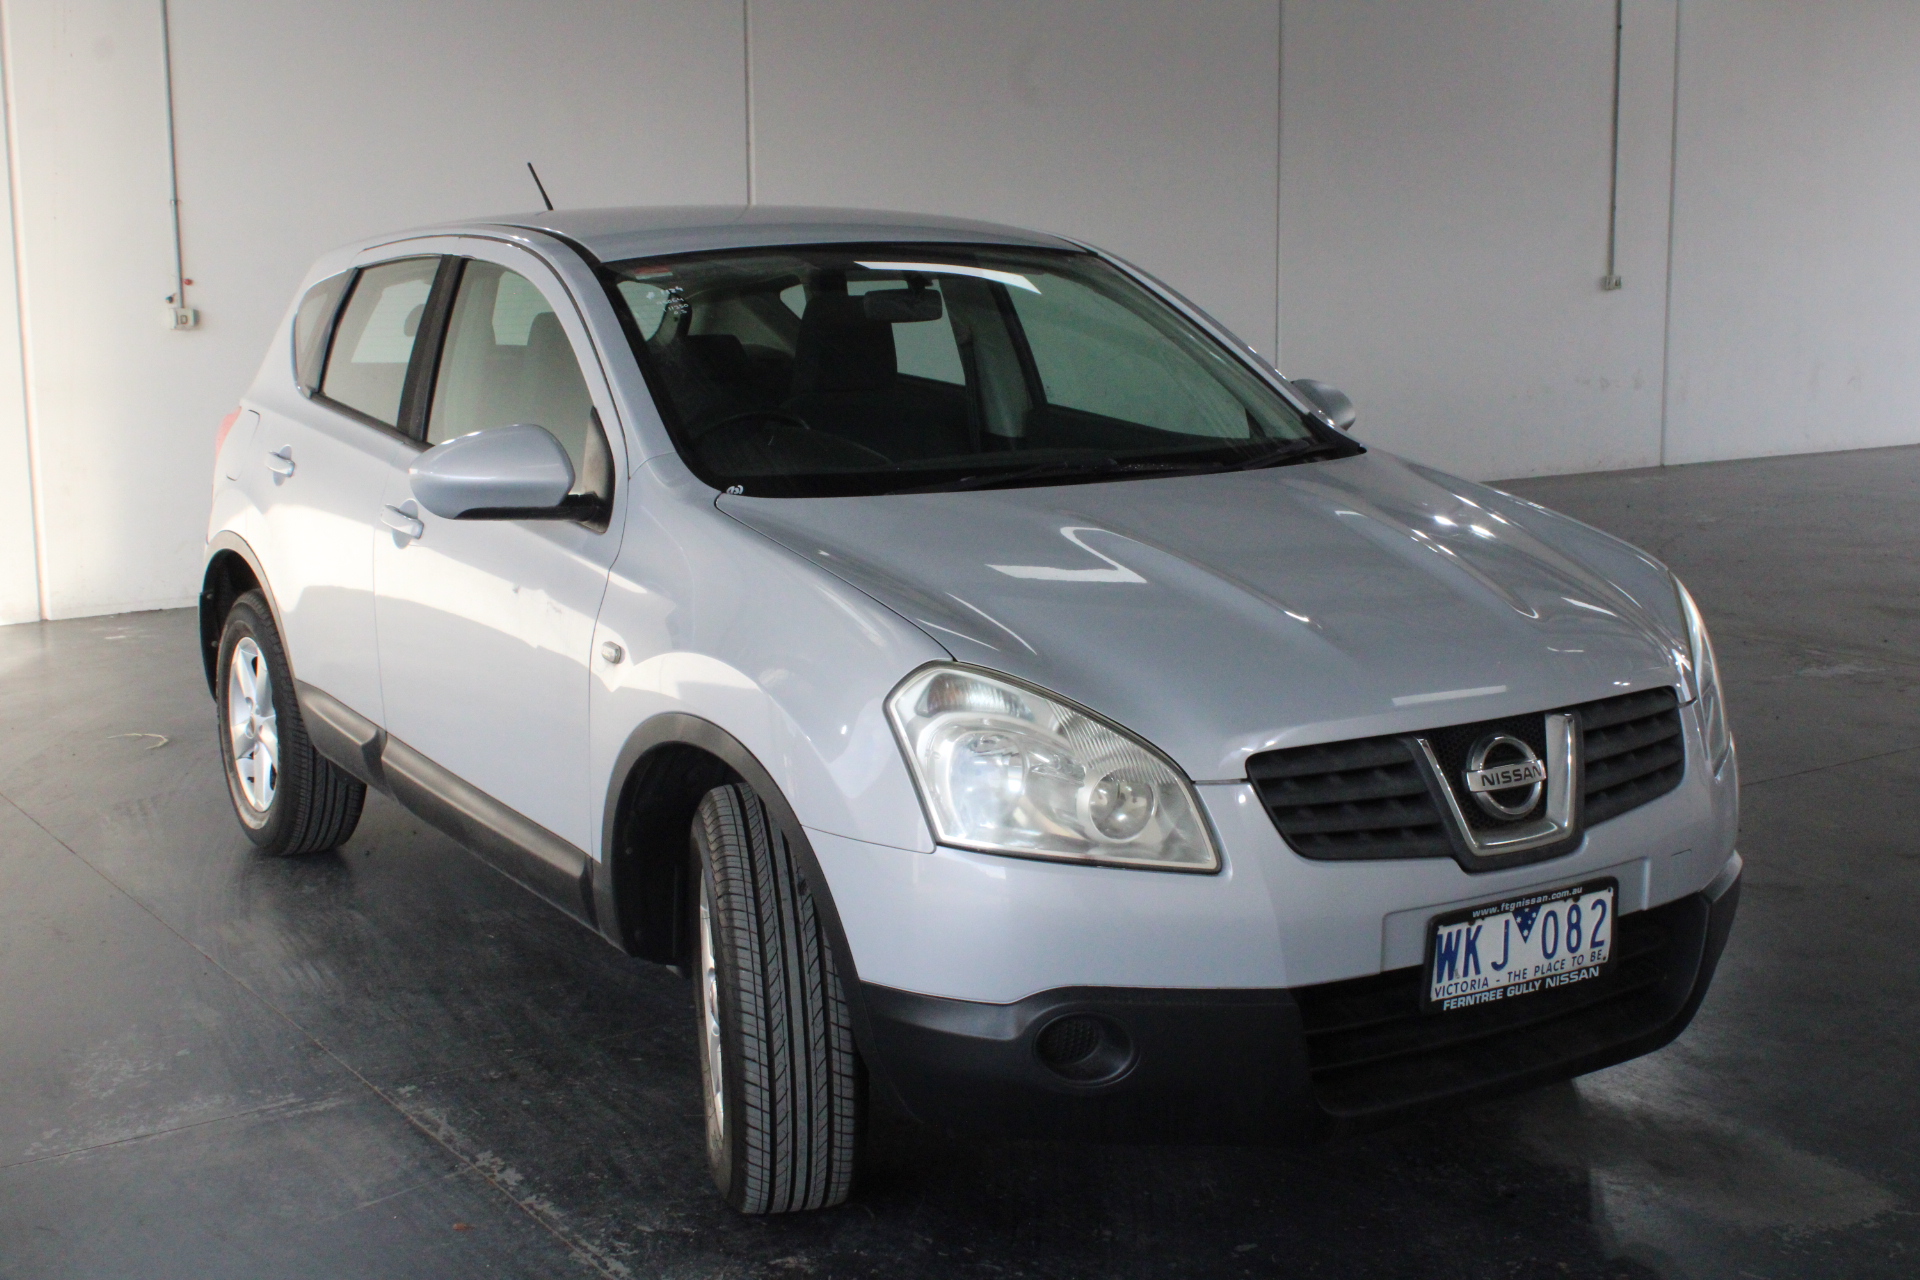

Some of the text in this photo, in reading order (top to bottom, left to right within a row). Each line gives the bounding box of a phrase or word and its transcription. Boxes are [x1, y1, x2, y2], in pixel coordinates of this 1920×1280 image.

[1481, 766, 1542, 787] NISSAN
[1472, 887, 1582, 917] www.ftgnissan.com.au
[1541, 898, 1607, 960] 082
[1435, 977, 1489, 998] VICTORIA
[1507, 968, 1528, 982] THE
[1533, 959, 1566, 977] PLACE
[1571, 954, 1585, 967] TO
[1443, 966, 1600, 1011] FERNTREE GULLY NISSAN
